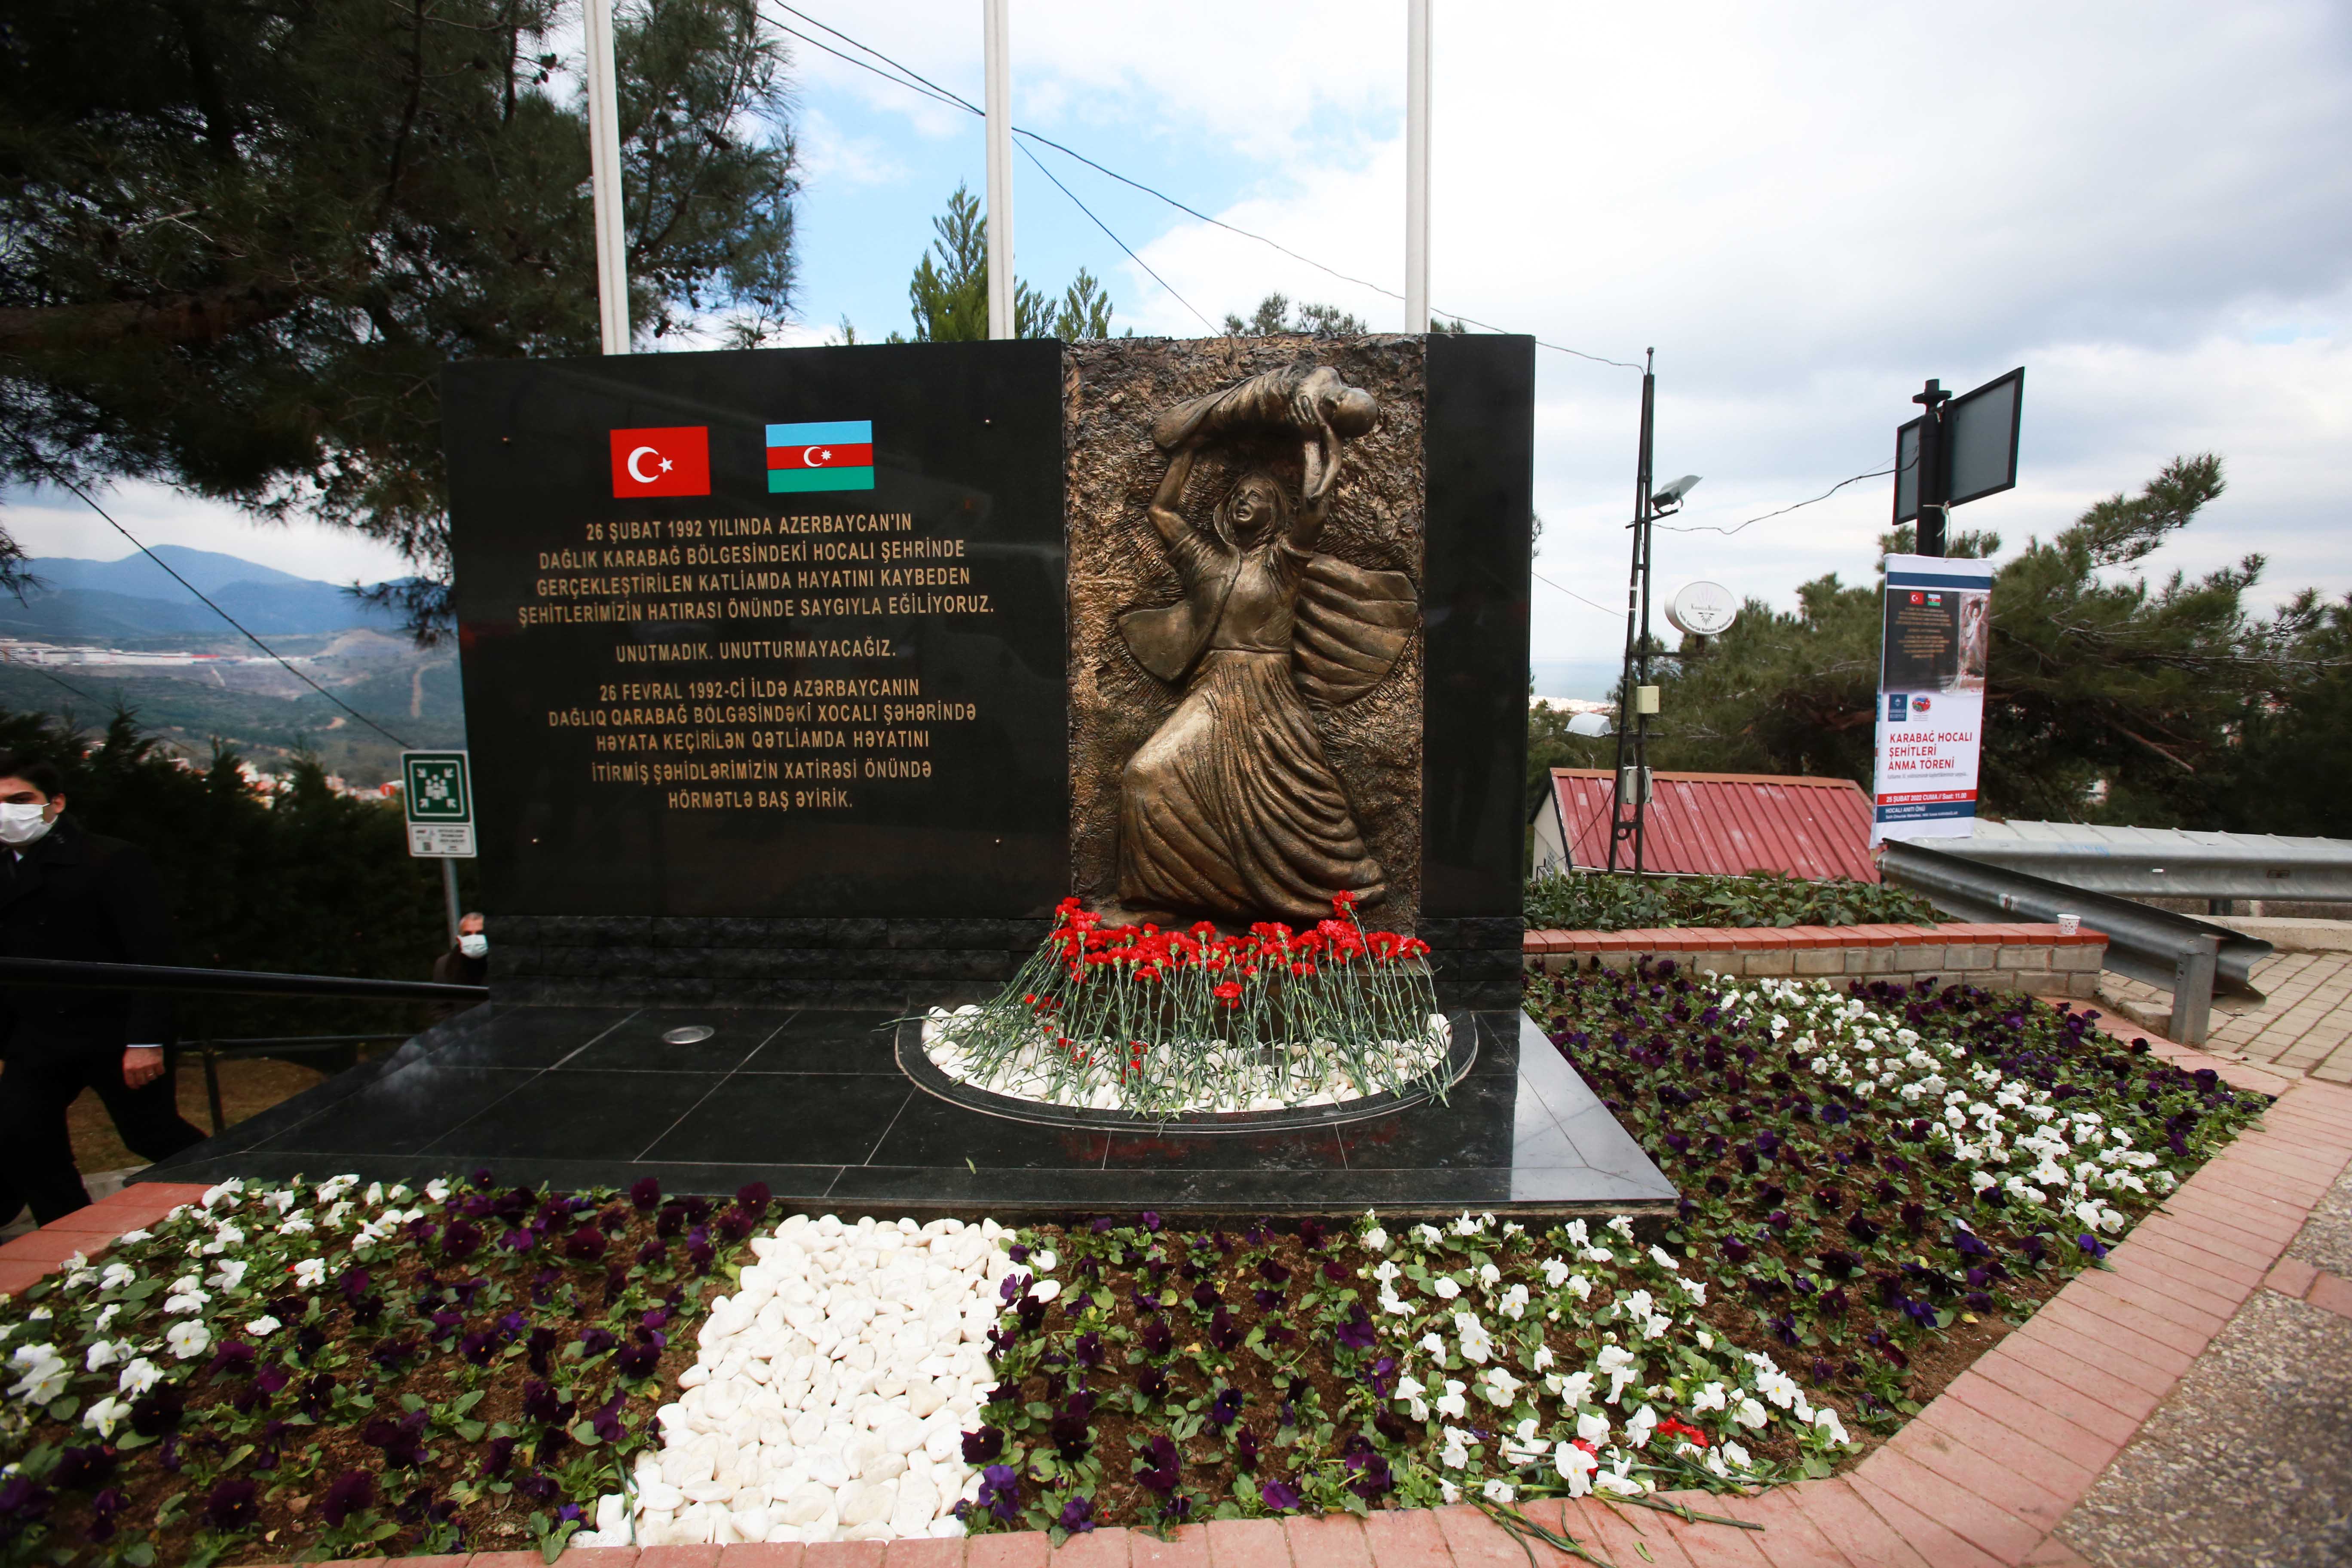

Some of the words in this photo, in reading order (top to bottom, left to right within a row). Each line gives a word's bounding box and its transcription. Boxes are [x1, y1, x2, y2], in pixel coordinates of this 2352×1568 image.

[586, 524, 603, 540] 26
[609, 521, 661, 544] ŞUBAT
[668, 520, 702, 537] 1992
[708, 518, 772, 536] YILINDA
[779, 513, 911, 534] AZERBAYCAN'IN
[539, 549, 597, 570] DAĞLIK
[603, 545, 680, 567] KARABAĞ
[687, 540, 806, 565] BÖLGESİNDEKİ
[814, 542, 874, 560] HOCALI
[881, 537, 965, 563] ŞEHRİNDE
[536, 573, 692, 599] GERÇEKLEŞTİRİLEN
[699, 570, 791, 591] KATLİAMDA
[798, 570, 873, 588] HAYATINI
[881, 568, 970, 586] KAYBEDEN
[518, 601, 641, 628] ŞEHİTLERİMİZİN
[648, 602, 721, 621] HATIRASI
[728, 598, 794, 618] ÖNÜNDE
[801, 597, 882, 616] SAYGIYLA
[889, 593, 993, 614] EĞİLİYORUZ.
[616, 643, 713, 662] UNUTMADIK.
[720, 636, 896, 659] UNUTTURMAYACAĞIZ.
[600, 685, 616, 701] 26
[622, 683, 682, 701] FEVRAL
[689, 677, 745, 698] 1992-Cİ
[751, 677, 787, 697] İLDƏ
[793, 679, 919, 697] AZƏRBAYCANIN
[548, 708, 606, 726] DAĞLIQ
[611, 704, 687, 726] QARABAĞ
[694, 702, 812, 723] BÖLGƏSİNDƏKİ
[818, 704, 876, 722] XOCALI
[883, 700, 976, 725] ŞƏHƏRİNDƏ
[596, 734, 658, 751] HƏYATA
[664, 729, 745, 753] KEÇİRİLƏN
[752, 728, 845, 749] QƏTLİAMDA
[854, 730, 929, 747] HƏYATINI
[1890, 730, 1934, 743] KARABAĞ
[1938, 732, 1972, 742] HOCALI
[1888, 760, 1916, 771] ANMA
[1920, 756, 1954, 769] TÖRENİ
[1889, 744, 1936, 759] ŞEHİTLERİ
[592, 762, 649, 784] İTİRMİŞ
[653, 760, 778, 784] ŞƏHİDLƏRİMİZİN
[785, 758, 857, 778] XATİRƏSİ
[865, 758, 932, 778] ÖNÜNDƏ
[668, 789, 753, 808] HÖRMƏTLƏ
[759, 790, 789, 811] BAŞ
[796, 787, 852, 807] ƏYİRİK.
[1893, 795, 1910, 803] ŞUBAT
